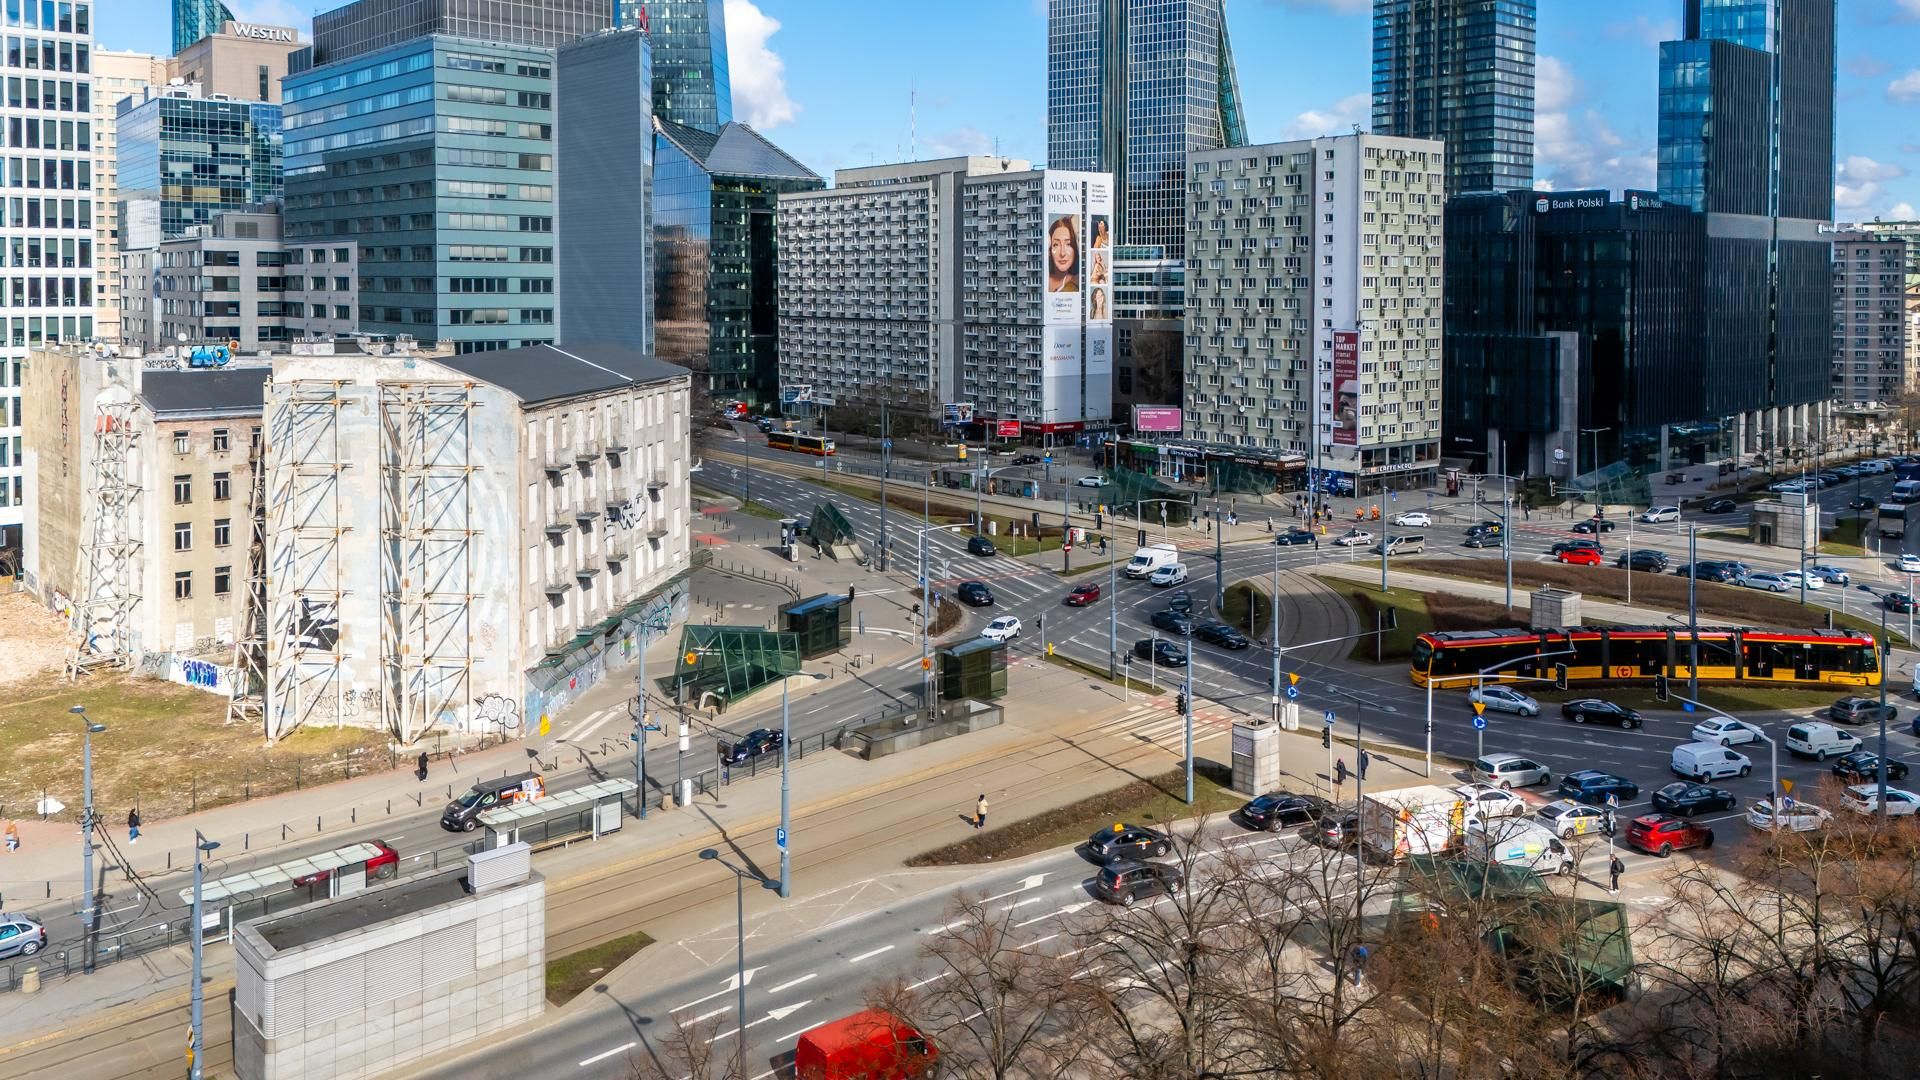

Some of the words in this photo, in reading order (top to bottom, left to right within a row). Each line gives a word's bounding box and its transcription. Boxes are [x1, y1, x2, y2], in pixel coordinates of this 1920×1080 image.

[232, 22, 292, 42] WESTIN
[1050, 181, 1078, 191] ALBUM
[1049, 194, 1080, 205] PIĘKNA
[1552, 199, 1575, 209] Bank
[1577, 197, 1604, 208] Polski
[1639, 199, 1650, 209] Bank
[1335, 343, 1356, 351] MARKET
